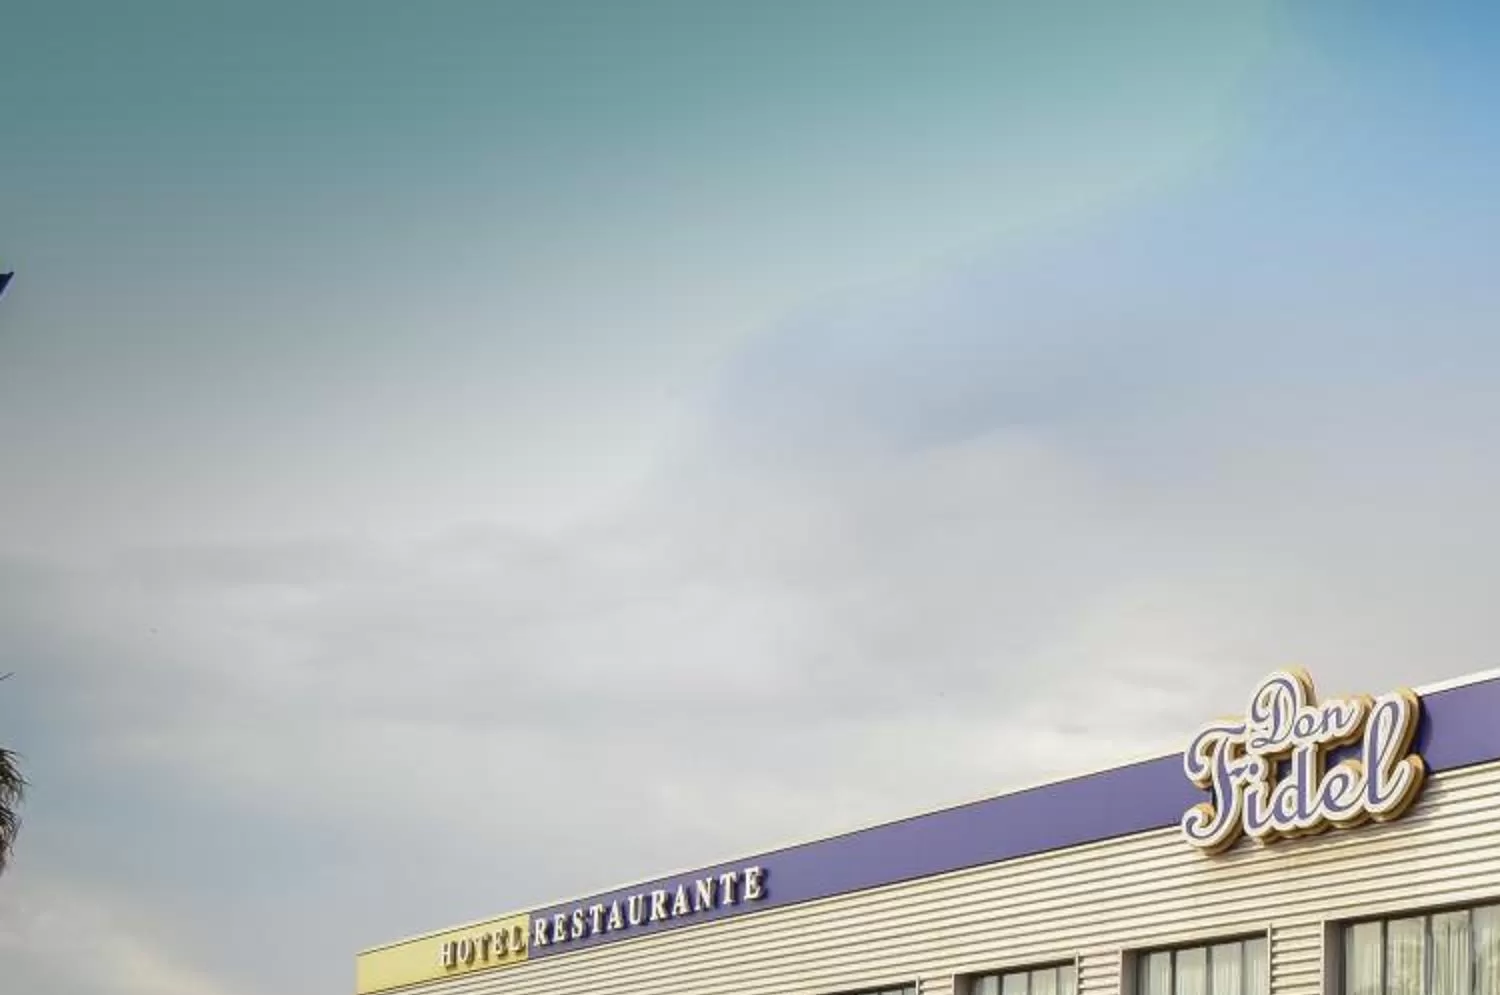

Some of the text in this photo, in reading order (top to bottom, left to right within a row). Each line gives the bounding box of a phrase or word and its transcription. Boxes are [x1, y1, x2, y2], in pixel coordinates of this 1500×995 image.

[1250, 677, 1356, 749] Don
[1184, 699, 1411, 839] Fidel
[438, 866, 765, 968] HOTEL RESTAURANTE
